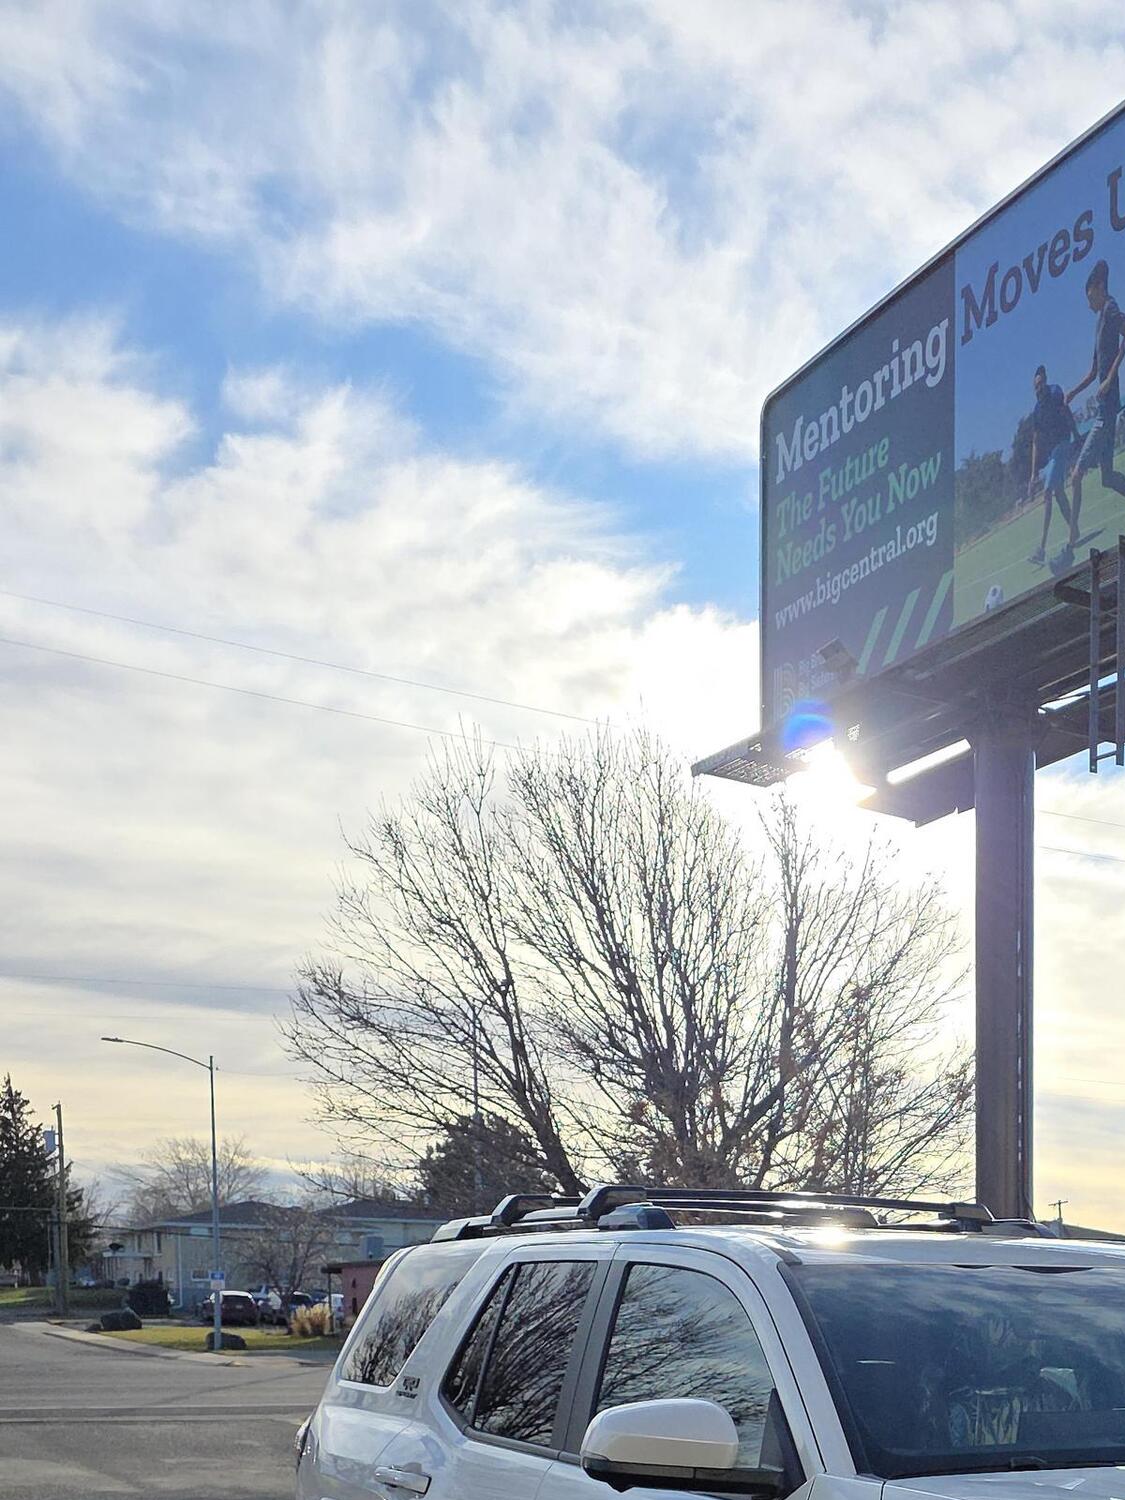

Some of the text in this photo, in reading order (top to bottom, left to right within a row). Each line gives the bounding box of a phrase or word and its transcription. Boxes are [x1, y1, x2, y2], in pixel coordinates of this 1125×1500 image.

[775, 317, 949, 485] Mentoring
[959, 211, 1094, 346] Moves
[776, 437, 889, 539] The Future
[776, 451, 942, 586] Needs You Now
[775, 511, 939, 631] www.bigcentral.org
